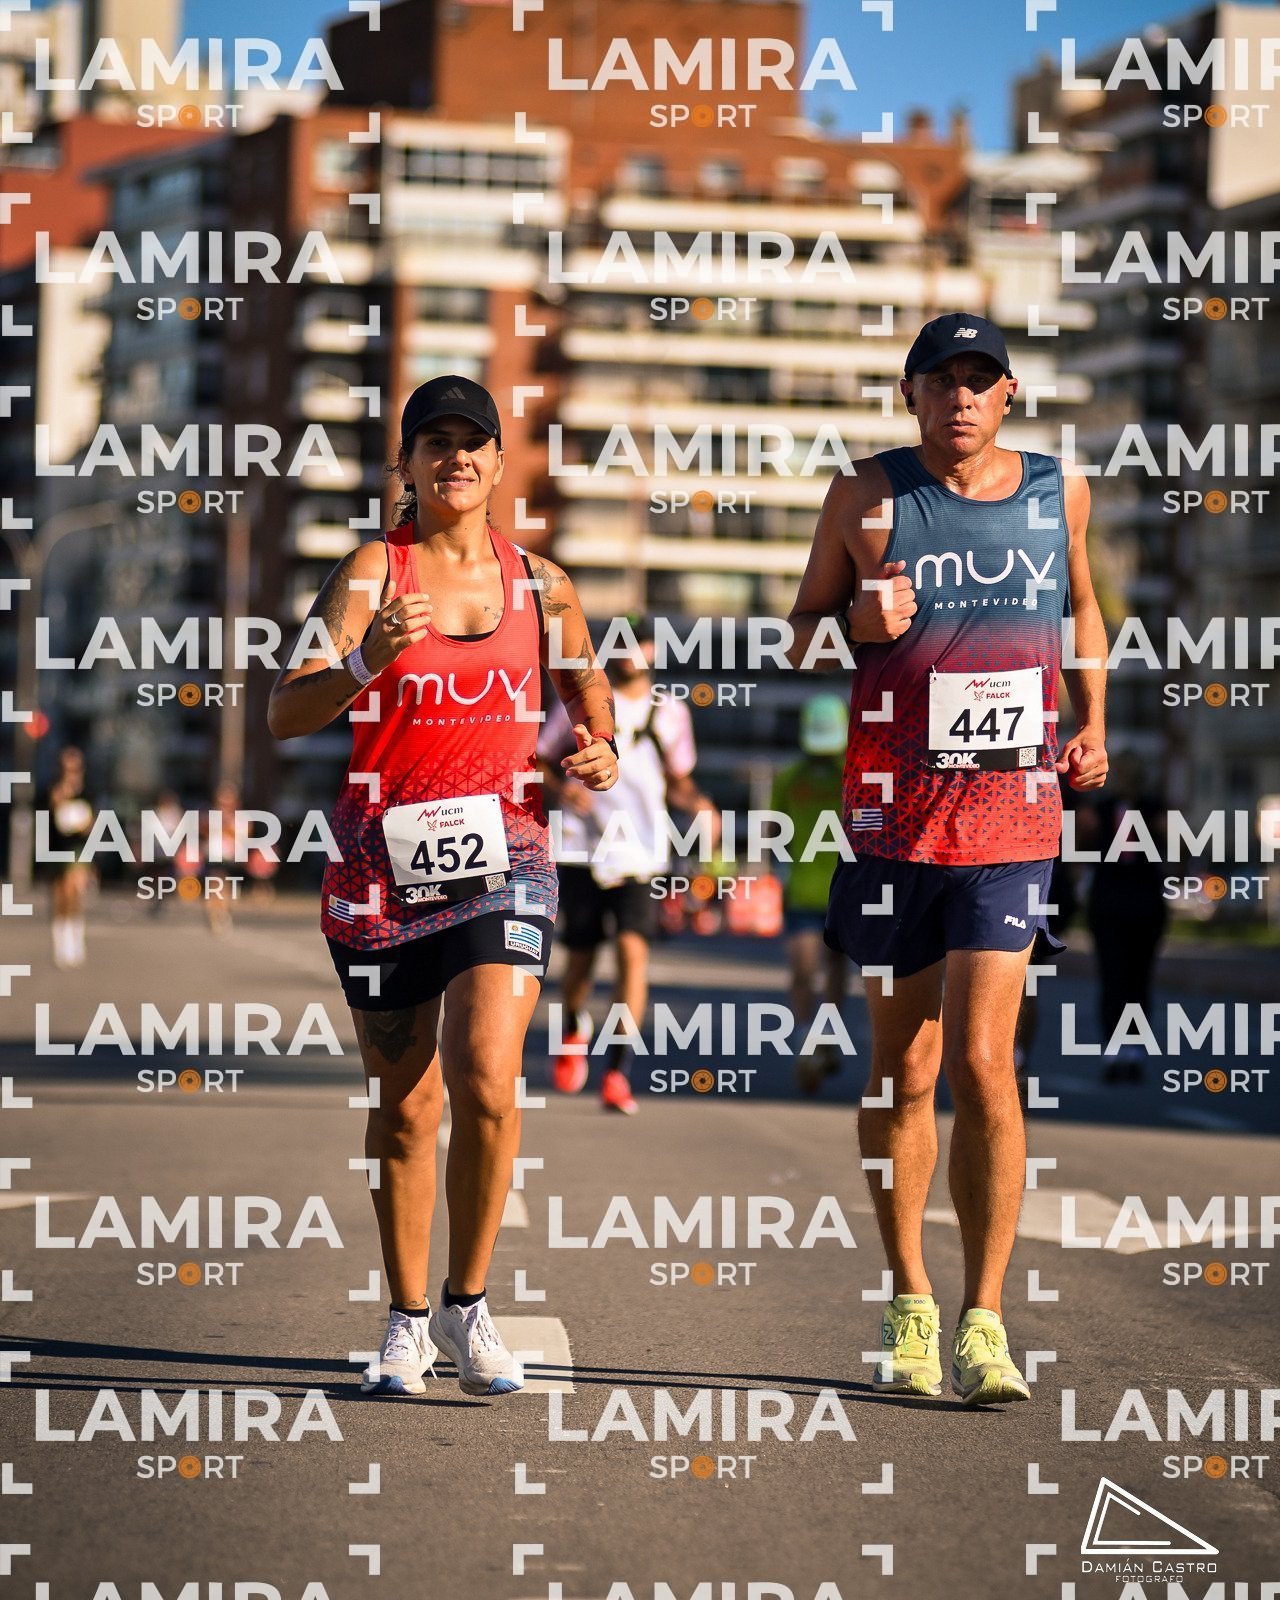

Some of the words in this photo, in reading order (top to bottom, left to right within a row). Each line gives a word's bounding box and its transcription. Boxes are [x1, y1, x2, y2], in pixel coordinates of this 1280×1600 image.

[934, 597, 1038, 610] MONTEVIDEO
[986, 691, 1011, 700] FALCK
[412, 714, 511, 726] MONTEVIDEO
[949, 706, 1025, 743] 447
[936, 752, 978, 769] 30K
[441, 806, 464, 816] ucm
[439, 818, 465, 829] FALCK
[410, 832, 488, 876] 452
[405, 884, 442, 904] 30K
[1004, 914, 1027, 930] FILA
